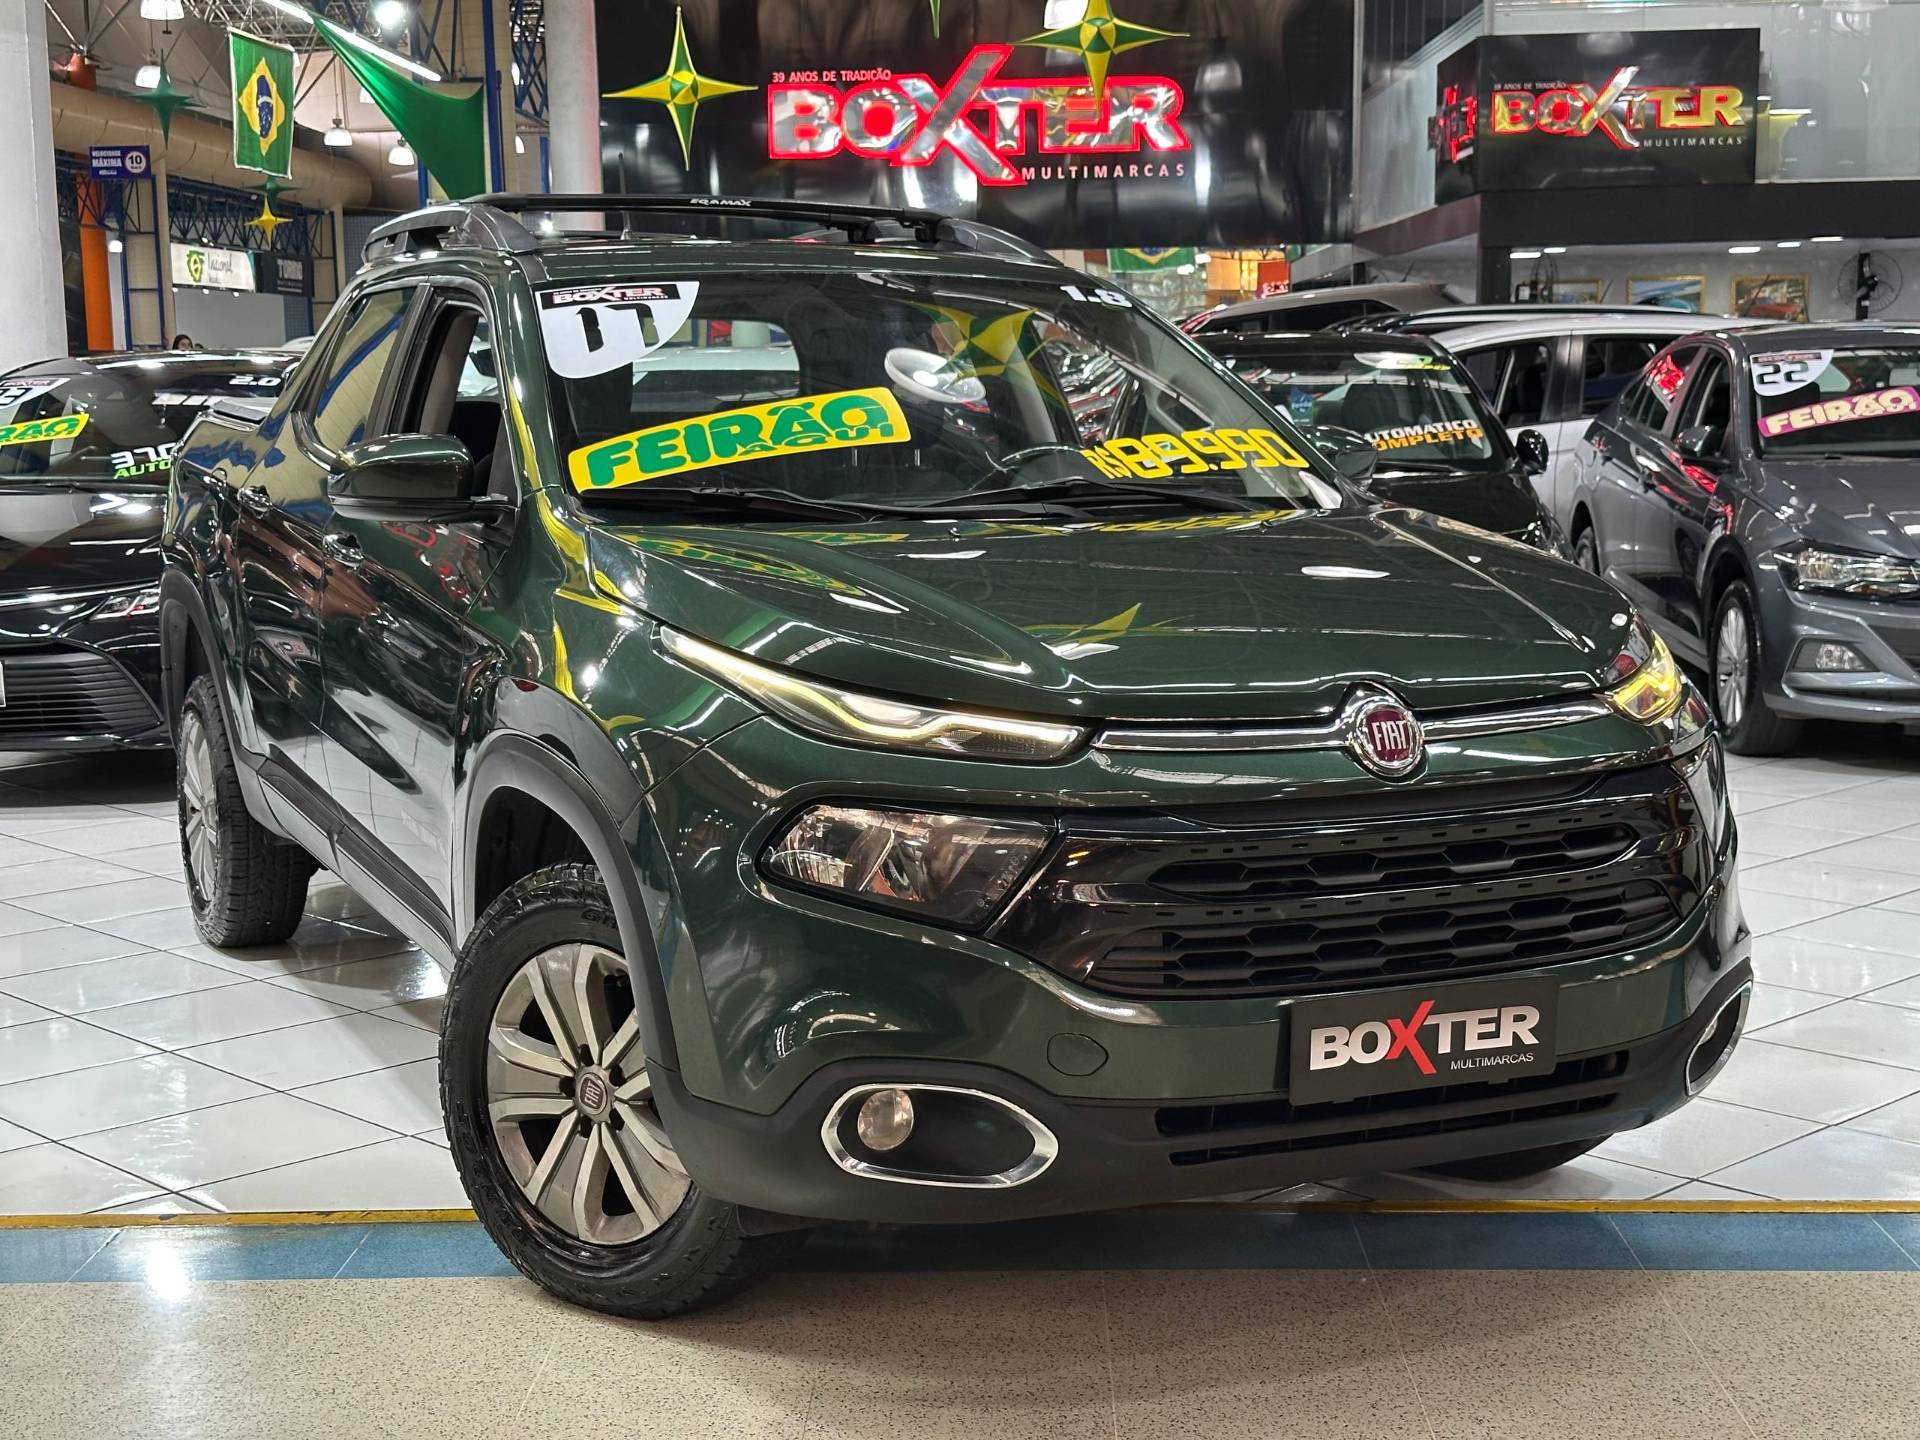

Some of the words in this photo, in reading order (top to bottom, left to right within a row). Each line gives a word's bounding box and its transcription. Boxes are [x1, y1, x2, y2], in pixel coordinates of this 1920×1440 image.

[771, 71, 786, 83] 39
[789, 71, 819, 83] ANOS
[822, 70, 838, 82] DE
[840, 66, 892, 84] TRADIÇÃO
[768, 43, 1192, 187] BOXTER
[1492, 65, 1746, 151] BOXTER
[1643, 136, 1743, 148] MULTIMARCAS
[128, 155, 143, 165] 10
[1021, 163, 1187, 182] MULTIMARCAS
[552, 286, 665, 305] BOXTER
[1060, 286, 1133, 308] 1.8
[228, 375, 281, 387] 2.0
[1756, 361, 1809, 385] 22
[1766, 389, 1914, 434] FEIRÃO
[585, 394, 890, 487] FEIRÃO
[1373, 429, 1484, 452] OMPLETO
[1371, 720, 1407, 751] FIAT
[1309, 1000, 1540, 1075] BOXTER
[1450, 1052, 1534, 1071] MULTIMARCAS
[584, 1079, 601, 1108] FIAT
